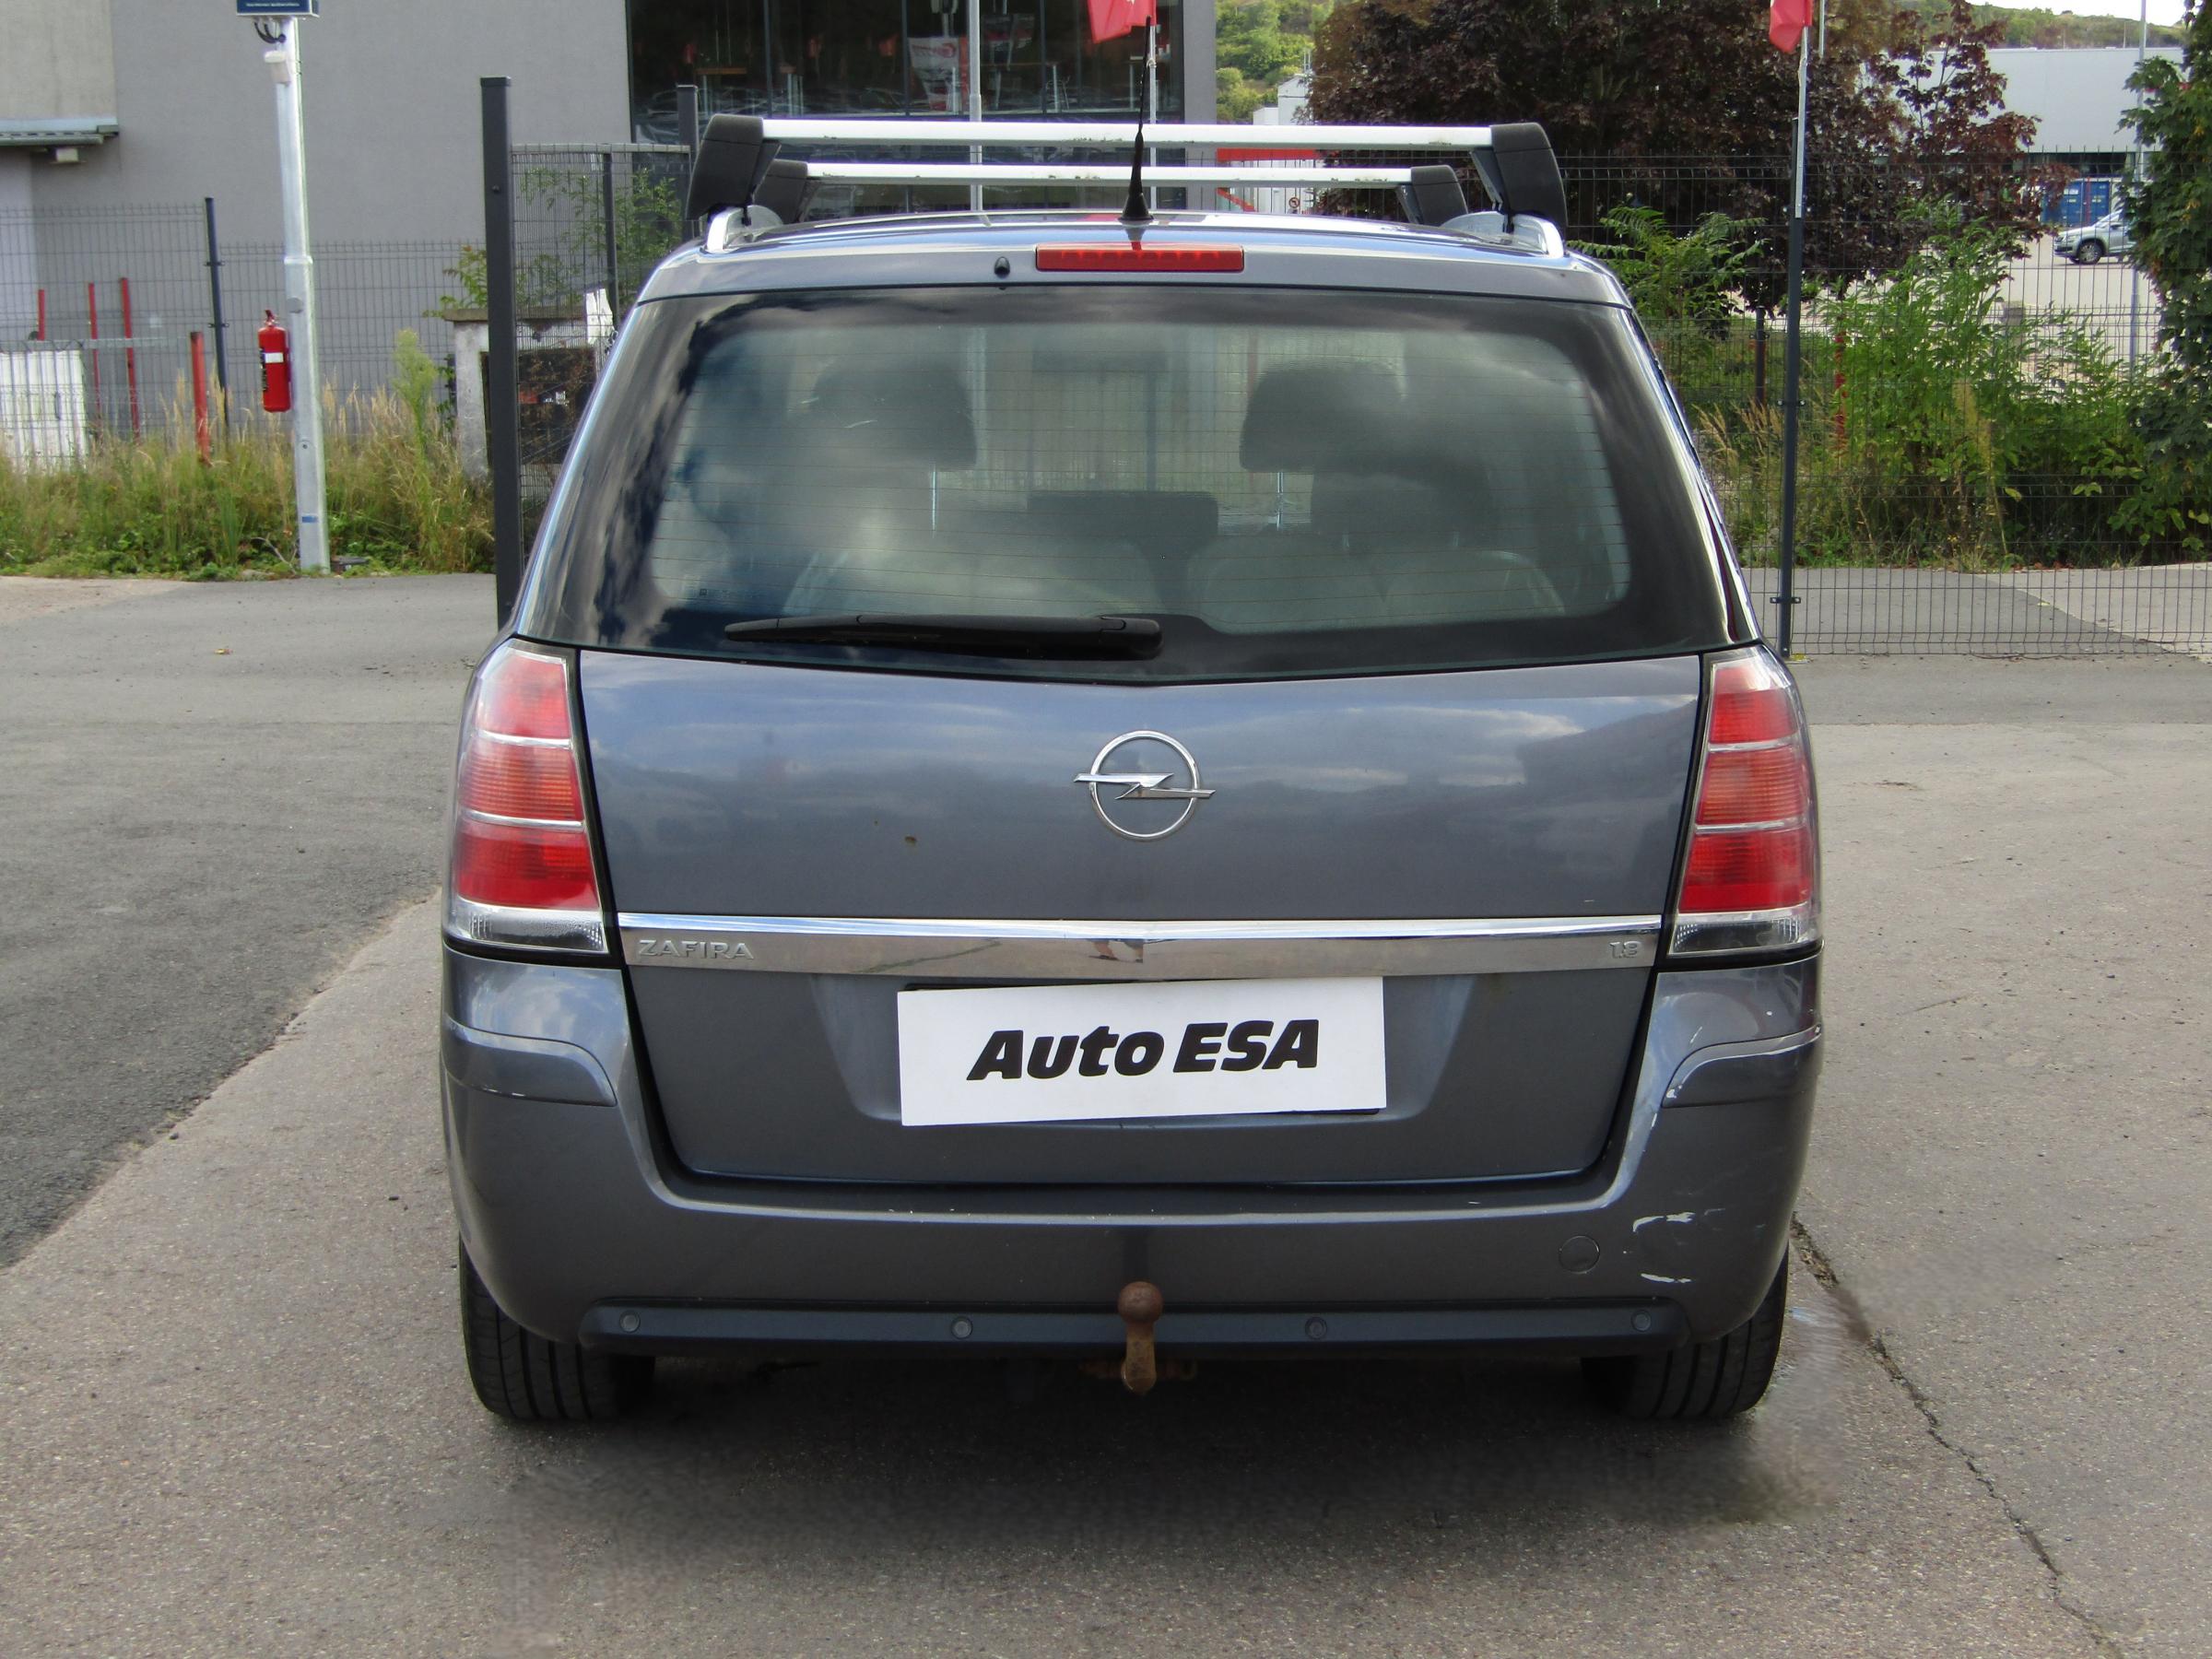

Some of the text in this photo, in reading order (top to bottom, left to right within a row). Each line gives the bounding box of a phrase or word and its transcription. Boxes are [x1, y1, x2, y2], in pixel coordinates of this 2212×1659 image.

[638, 939, 754, 959] ZAFIRA
[967, 1019, 1319, 1080] Auto ESA
